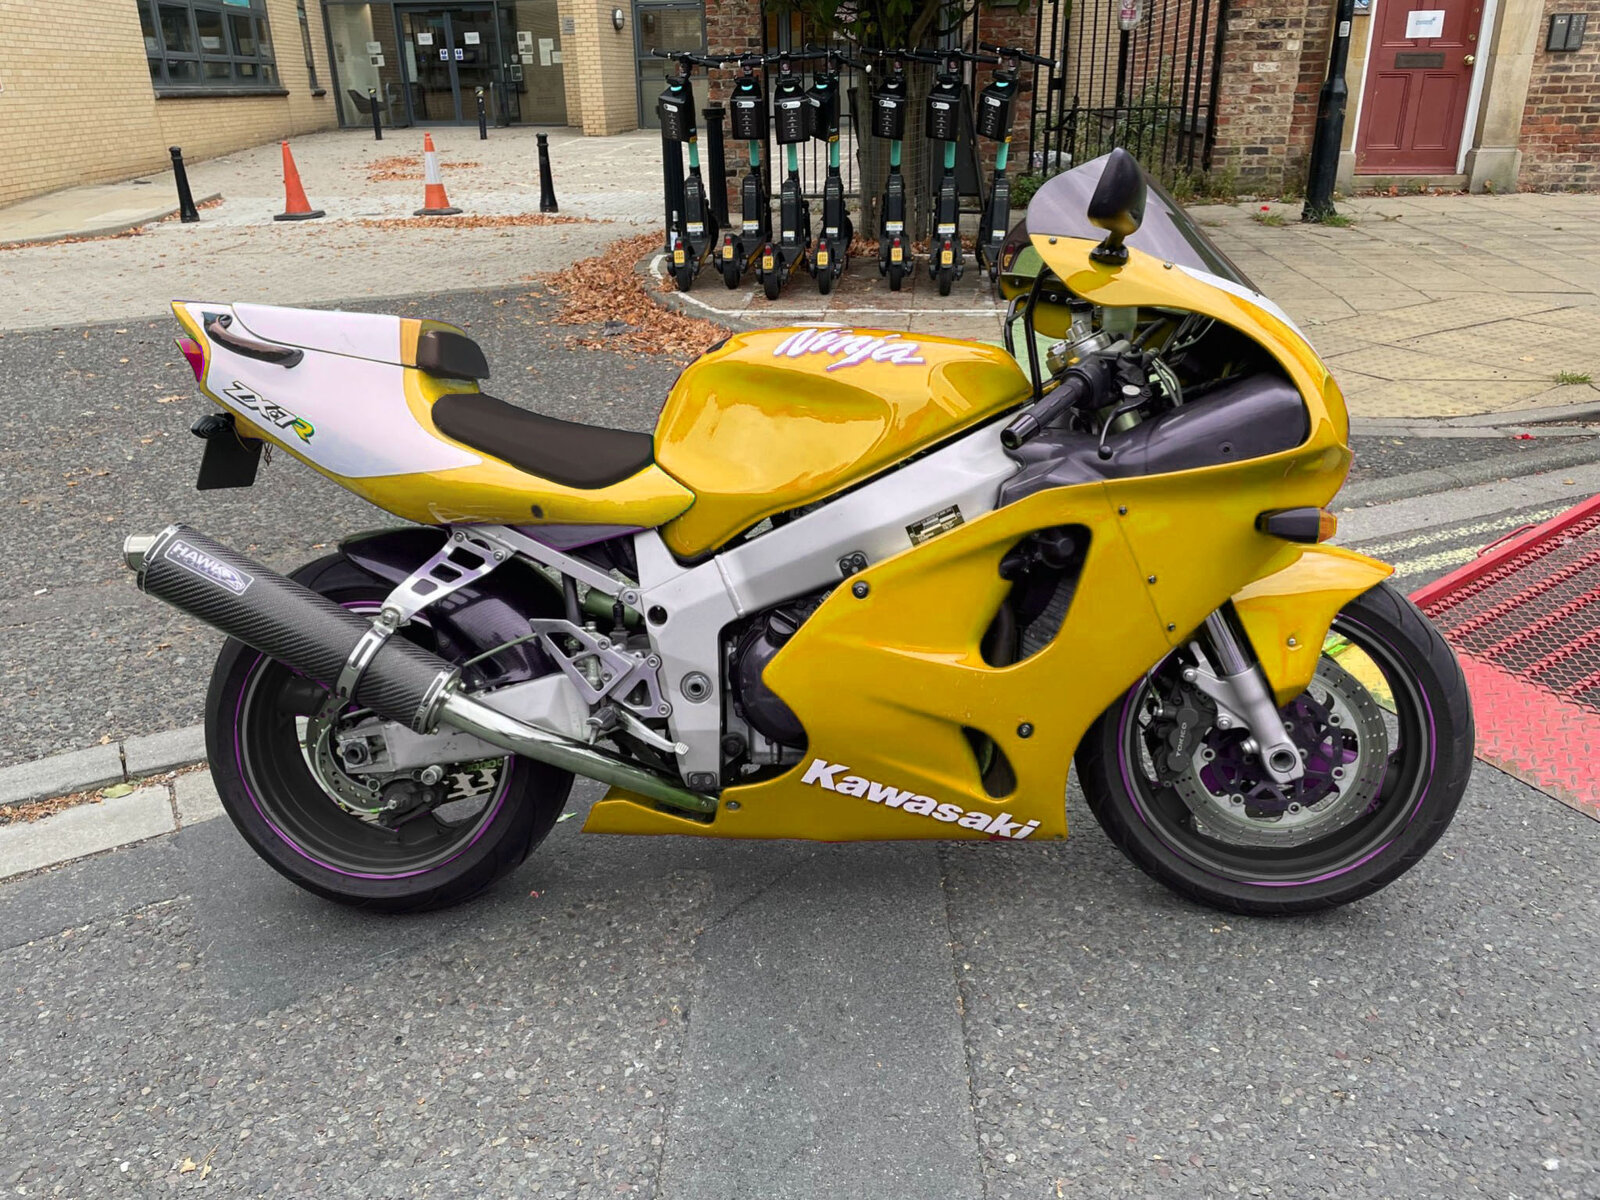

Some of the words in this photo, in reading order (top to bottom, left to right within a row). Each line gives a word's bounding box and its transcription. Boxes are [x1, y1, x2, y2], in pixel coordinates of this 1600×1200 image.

[773, 328, 926, 372] Ninja
[172, 543, 223, 576] HAWK
[1175, 721, 1187, 758] TOKICO
[800, 758, 1041, 840] Kawasaki
